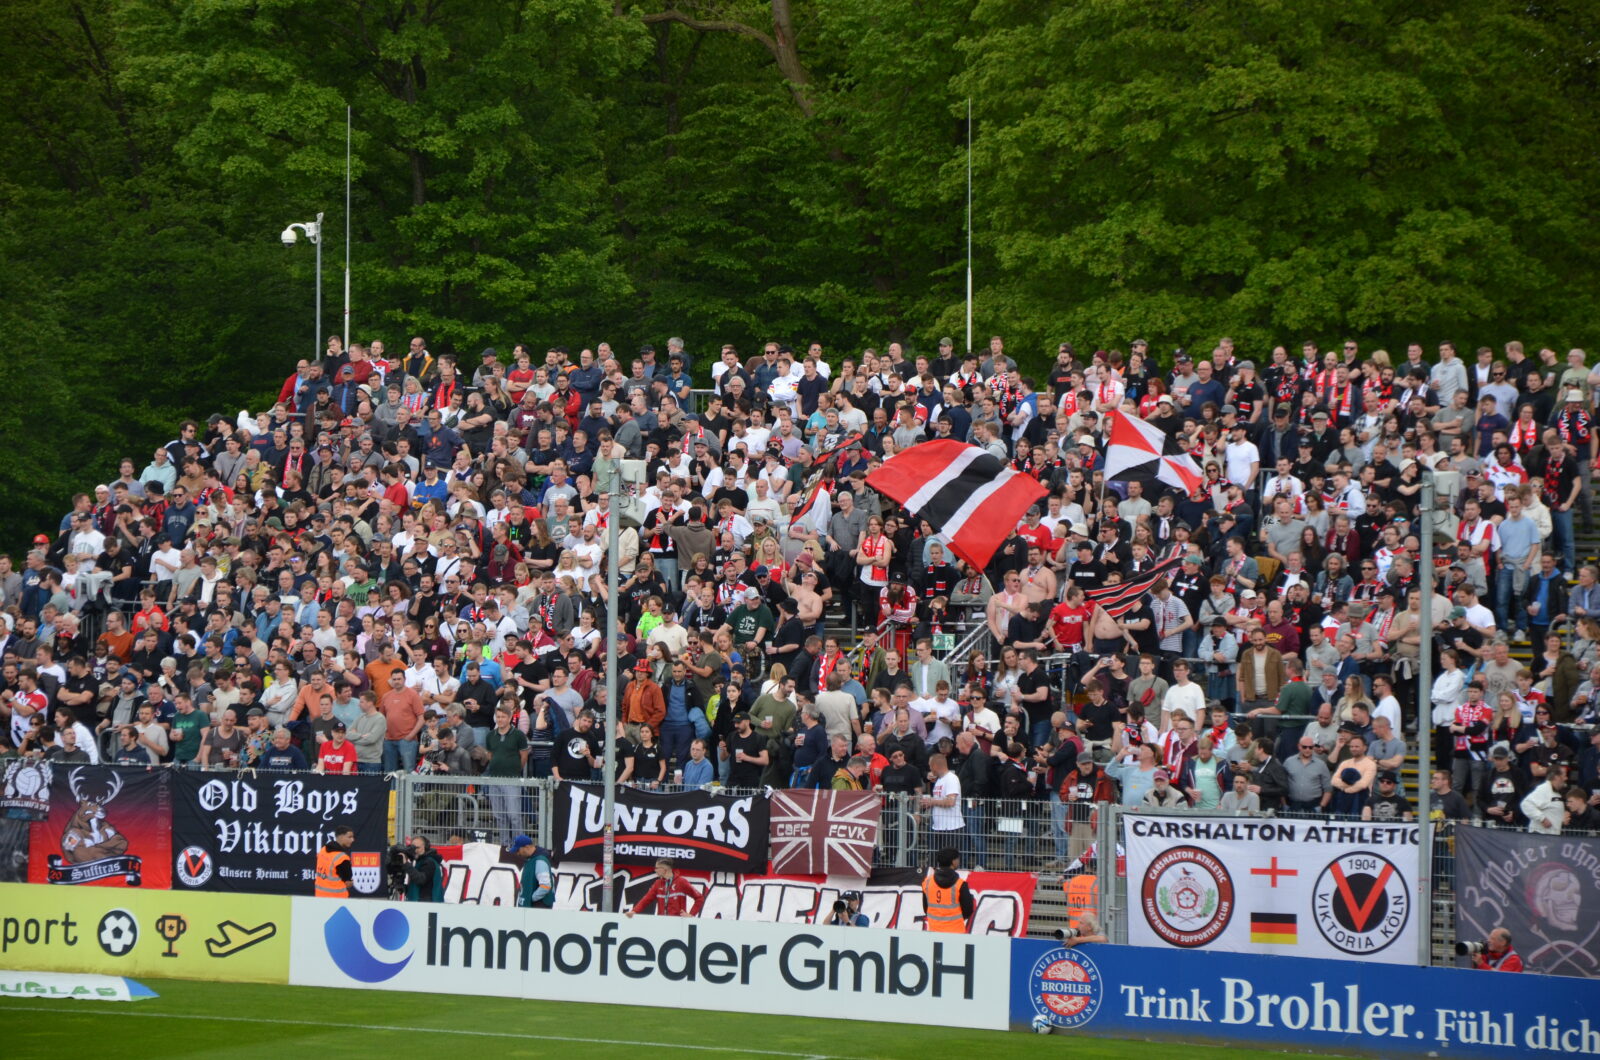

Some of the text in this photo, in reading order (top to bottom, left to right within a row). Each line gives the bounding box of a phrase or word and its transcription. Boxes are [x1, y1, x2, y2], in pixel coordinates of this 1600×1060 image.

[199, 778, 359, 820] Old Boys
[564, 785, 753, 855] JUNIORS
[829, 824, 868, 840] FCVK
[1132, 820, 1295, 842] CARSHALTON
[219, 866, 252, 879] Unsere
[255, 867, 289, 880] Heimat
[1149, 851, 1227, 883] CARSHALTON ATHLETIC
[1348, 859, 1377, 870] 1904
[936, 890, 942, 903] 9
[1072, 896, 1086, 909] 101
[2, 912, 79, 953] port
[1146, 898, 1180, 941] INDEPENDENT
[1219, 901, 1230, 921] CLUB
[1318, 892, 1404, 949] VIKTORIA KÖLN
[427, 911, 975, 1000] Immofeder GmbH
[1035, 951, 1098, 981] QUELLEN DES
[1041, 981, 1092, 994] BROHLER
[1035, 995, 1097, 1025] WOHLSEINS
[1120, 977, 1600, 1054] Trink Brohler. Fühl dich
